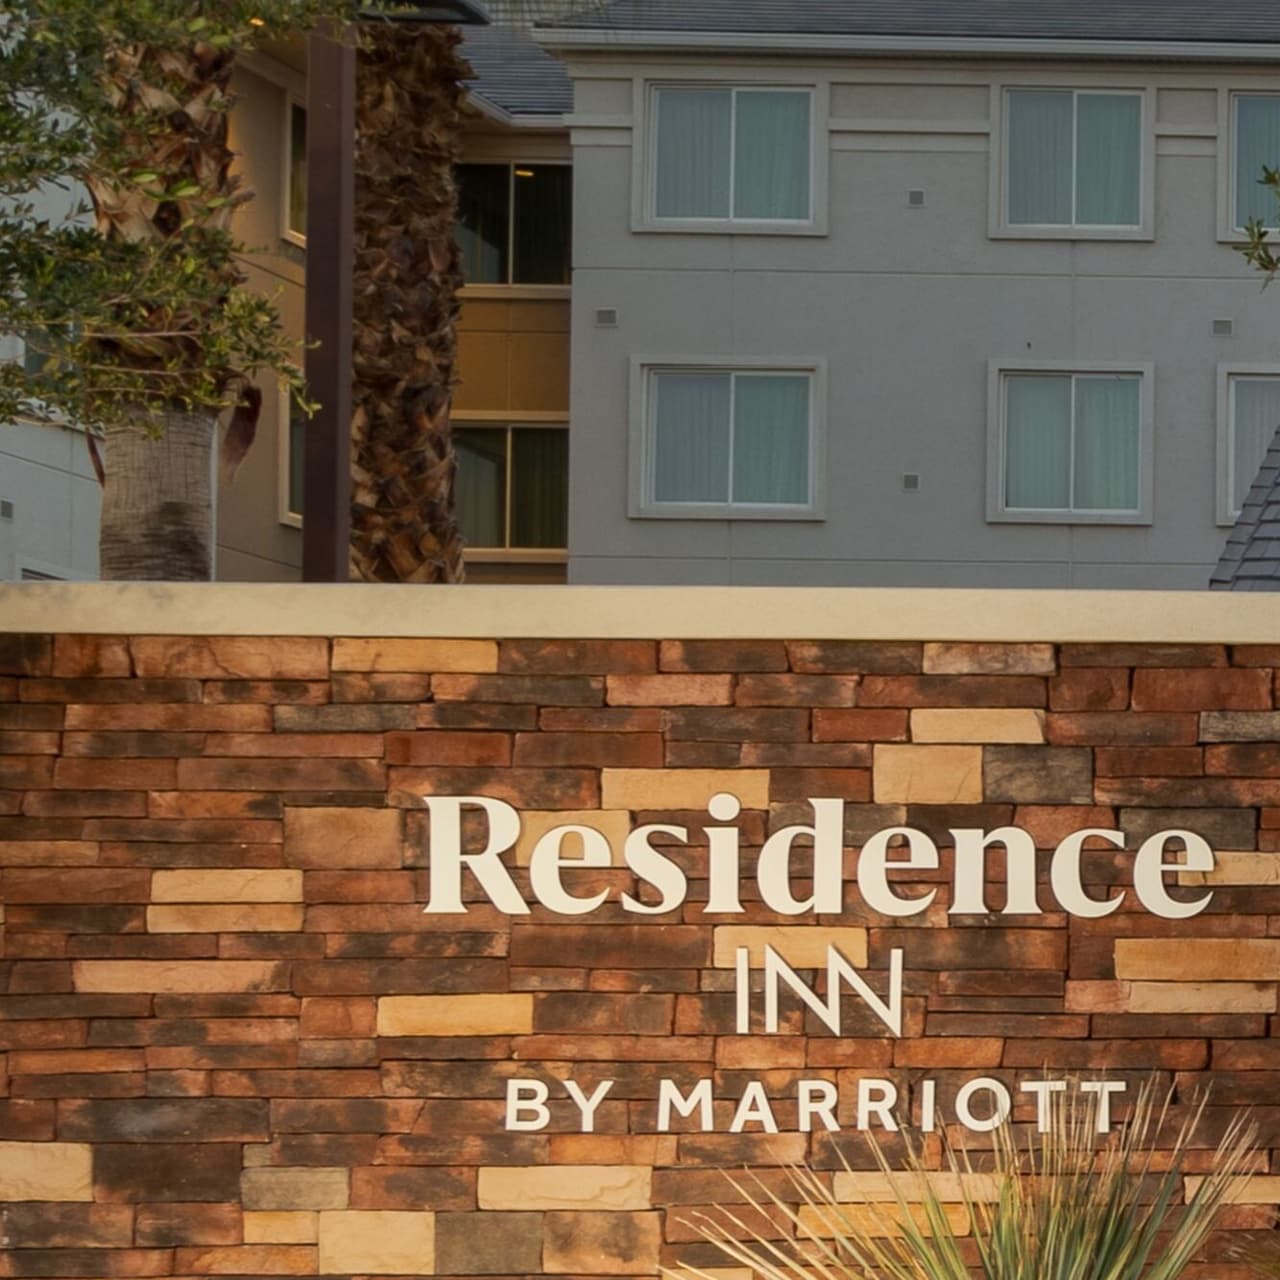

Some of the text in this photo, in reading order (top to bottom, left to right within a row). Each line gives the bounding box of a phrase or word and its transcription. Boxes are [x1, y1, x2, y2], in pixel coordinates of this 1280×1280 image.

[424, 793, 1215, 918] Residence
[735, 944, 904, 1038] INN
[505, 1077, 1127, 1134] BY MARRIOTT
